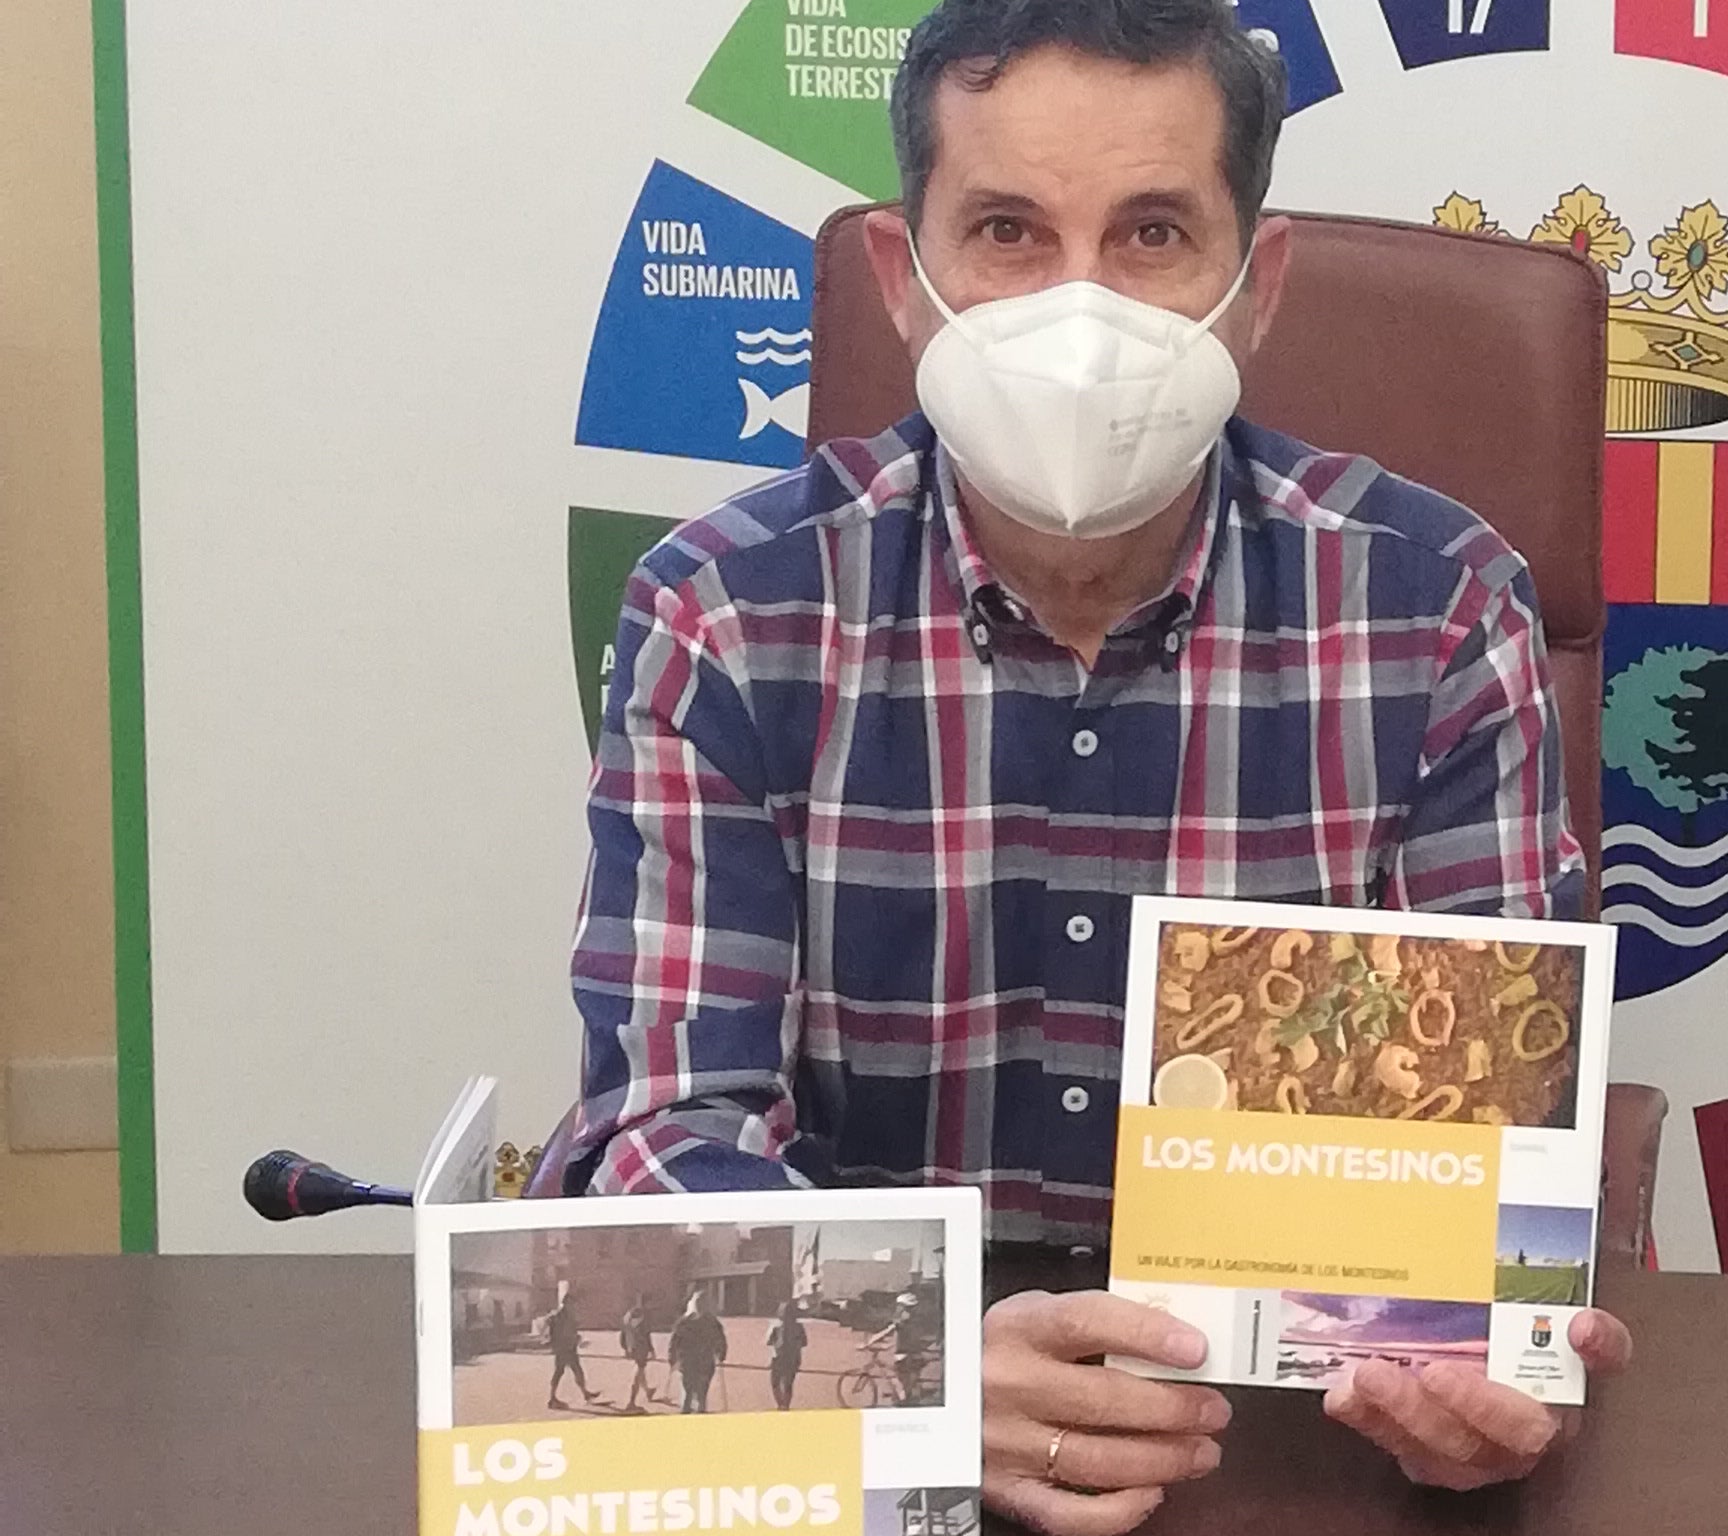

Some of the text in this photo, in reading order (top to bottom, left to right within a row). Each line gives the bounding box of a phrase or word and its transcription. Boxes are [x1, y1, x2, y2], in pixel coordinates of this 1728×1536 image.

[785, 24, 818, 57] DE
[642, 220, 706, 255] VIDA
[642, 263, 801, 301] SUBMARINA
[1143, 1135, 1486, 1186] LOS MONTESINOS
[453, 1438, 567, 1486] LOS
